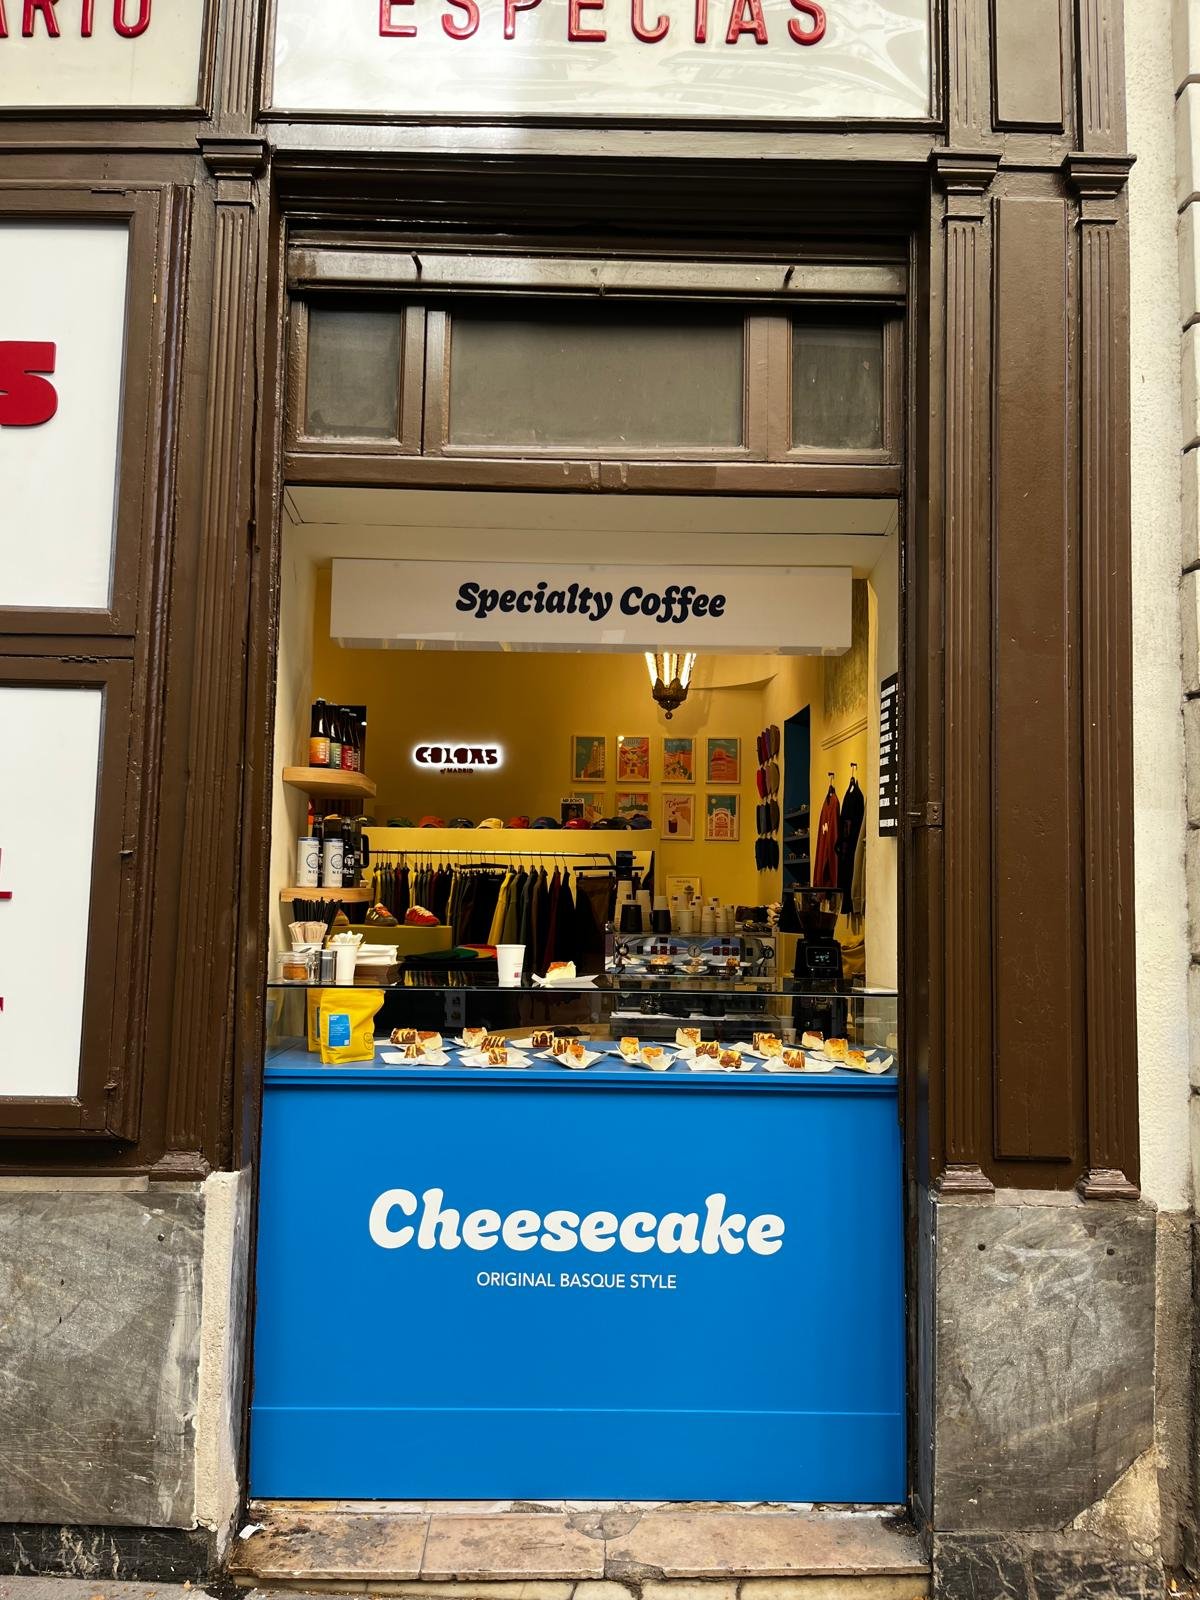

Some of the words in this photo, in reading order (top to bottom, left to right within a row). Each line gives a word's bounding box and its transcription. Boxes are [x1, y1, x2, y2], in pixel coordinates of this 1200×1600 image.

[379, 0, 827, 47] ESPECIAS
[455, 581, 614, 622] Specialty
[619, 585, 727, 624] Coffee
[447, 767, 474, 775] MADRID
[368, 1187, 786, 1256] Cheesecake
[476, 1271, 556, 1288] ORIGINAL
[559, 1272, 626, 1289] BASQUE
[629, 1273, 678, 1289] STYLE
